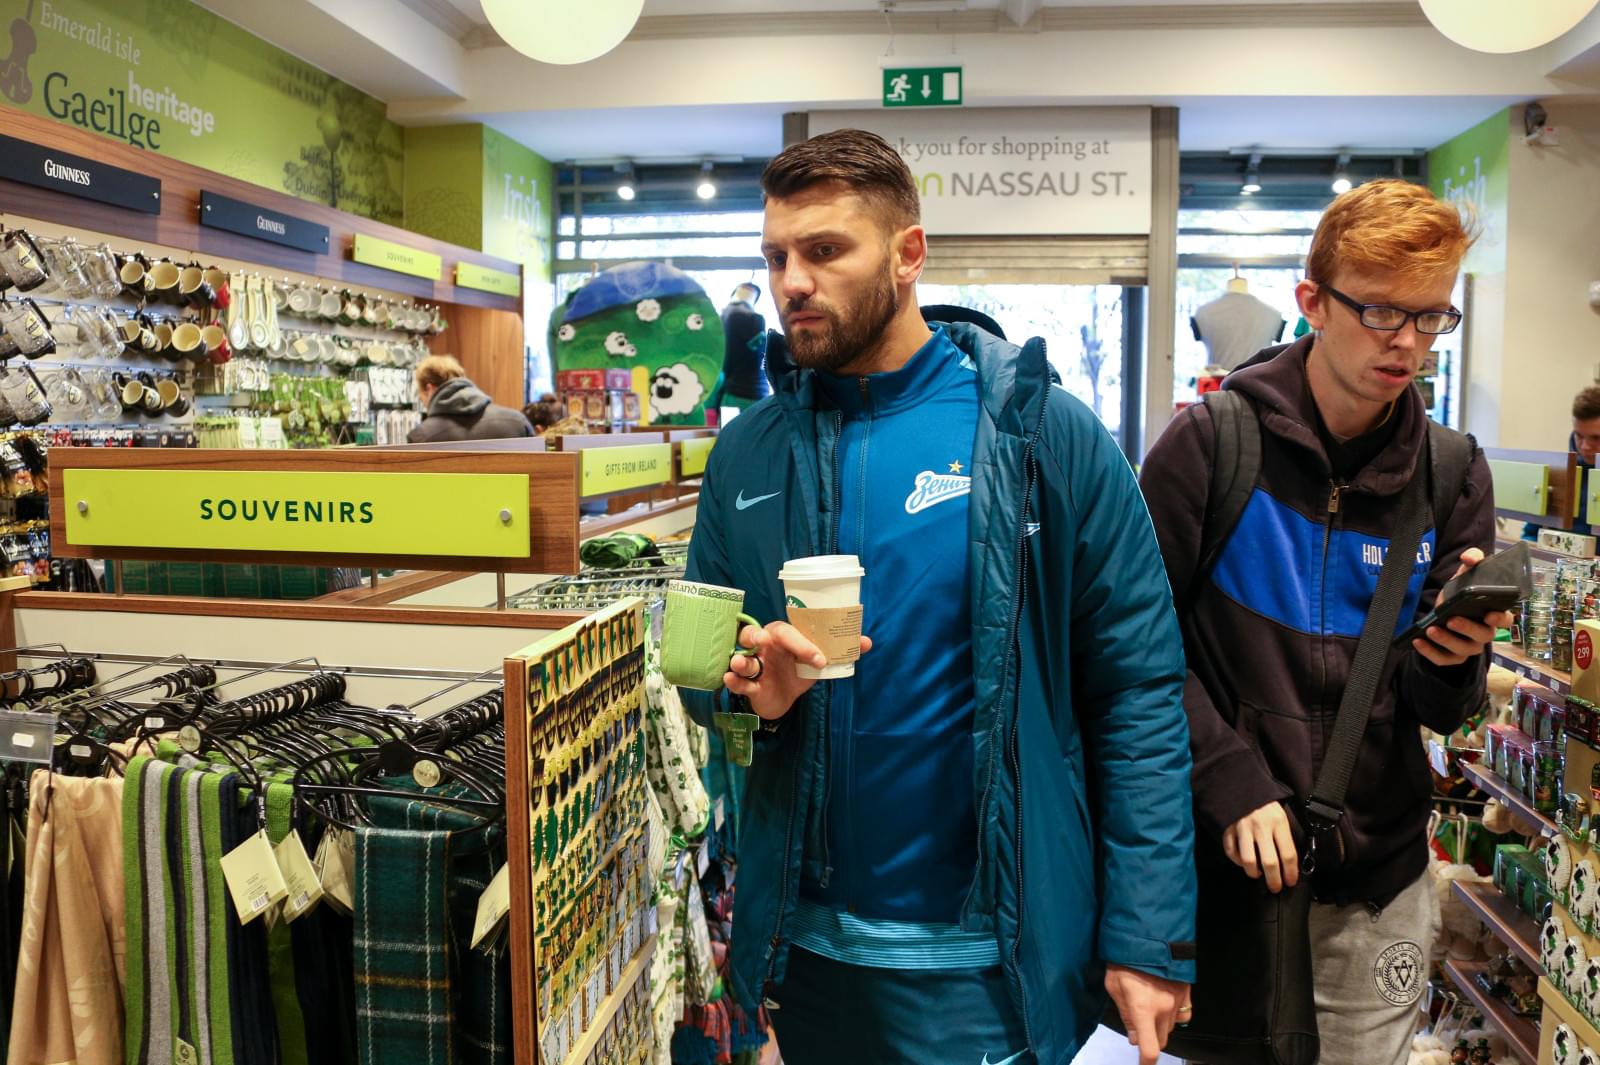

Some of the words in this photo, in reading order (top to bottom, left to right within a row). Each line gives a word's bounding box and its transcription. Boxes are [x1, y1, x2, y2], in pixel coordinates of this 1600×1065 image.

[40, 2, 112, 53] Emerald
[115, 33, 141, 65] isle
[43, 72, 161, 150] Gaeilge
[127, 70, 215, 137] heritage
[915, 142, 952, 162] you
[958, 137, 985, 155] for
[991, 136, 1087, 161] shopping
[1091, 138, 1110, 155] at
[951, 172, 1080, 197] NASSAU
[1091, 171, 1135, 197] ST.
[605, 463, 621, 476] GIFTS
[622, 461, 636, 474] FROM
[637, 459, 657, 472] IRELAND
[200, 498, 374, 524] SOUVENIRS
